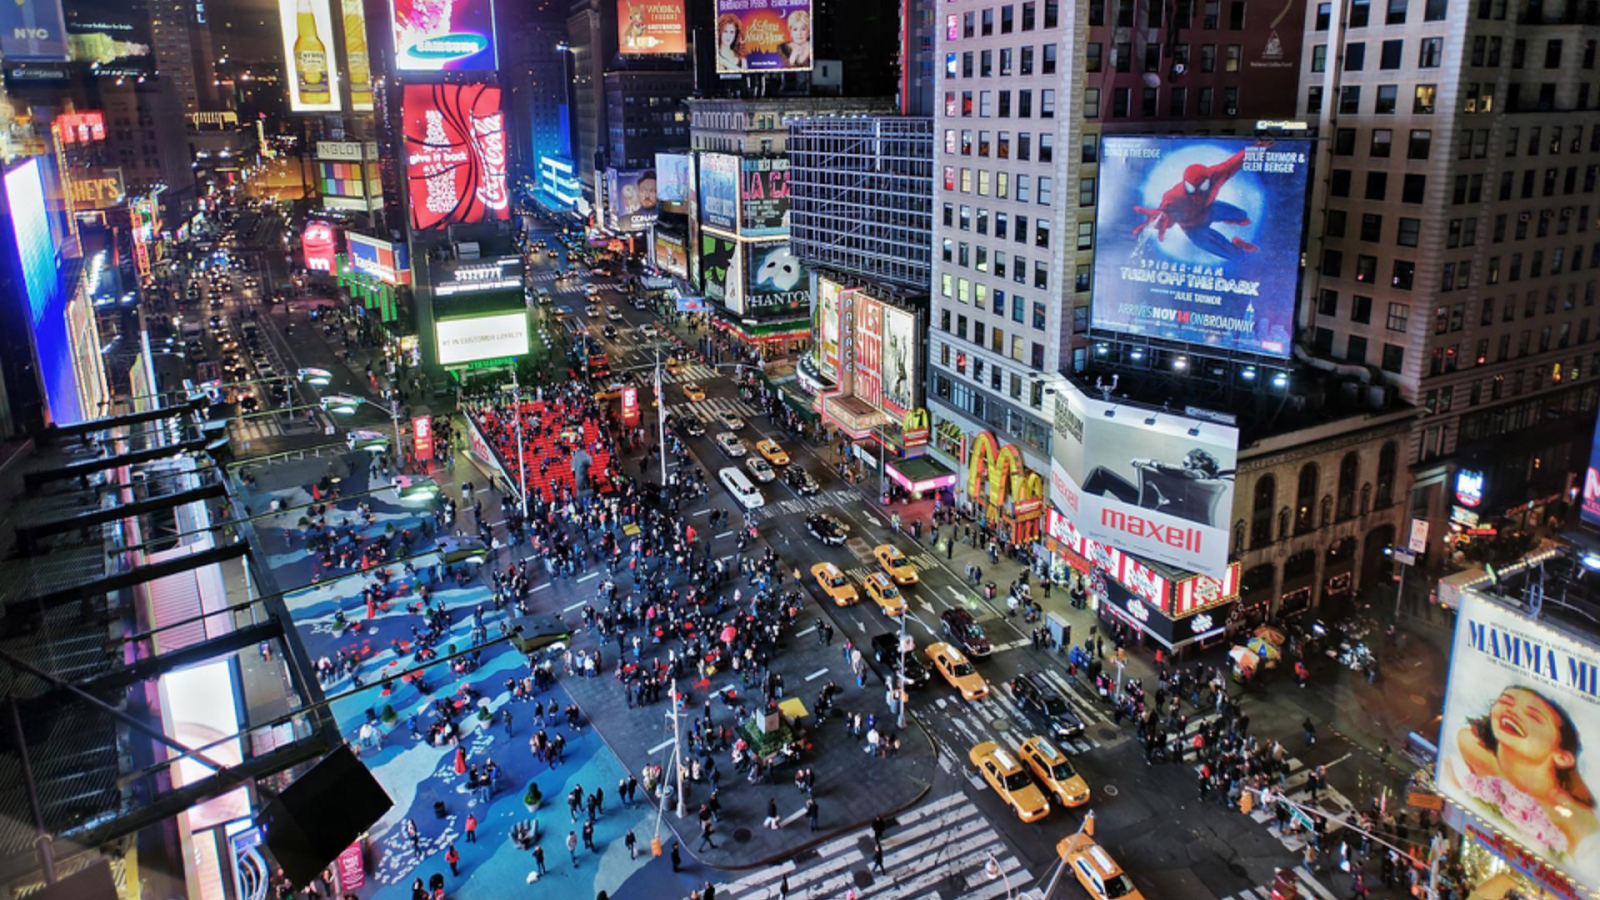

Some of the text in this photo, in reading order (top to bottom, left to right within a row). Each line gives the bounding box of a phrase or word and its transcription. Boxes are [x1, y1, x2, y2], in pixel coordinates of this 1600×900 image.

[14, 28, 49, 40] NYC
[410, 152, 431, 165] give
[433, 153, 441, 161] it
[1129, 149, 1142, 158] THE
[1142, 148, 1161, 159] EDGE
[1243, 151, 1305, 163] JULIE TAYMOR &
[1243, 162, 1294, 173] GLEN BERGER
[741, 171, 764, 200] LA
[1121, 267, 1259, 296] TURN OFF THE DARK
[1174, 291, 1192, 302] JULIE
[1118, 303, 1153, 318] ARRIVES
[1153, 307, 1177, 321] NOV
[1177, 311, 1190, 324] 14
[1190, 312, 1203, 325] ON
[1203, 314, 1255, 333] BROADWAY
[845, 298, 853, 373] PALACE
[1101, 508, 1202, 554] maxell
[1467, 618, 1558, 682] MAMMA
